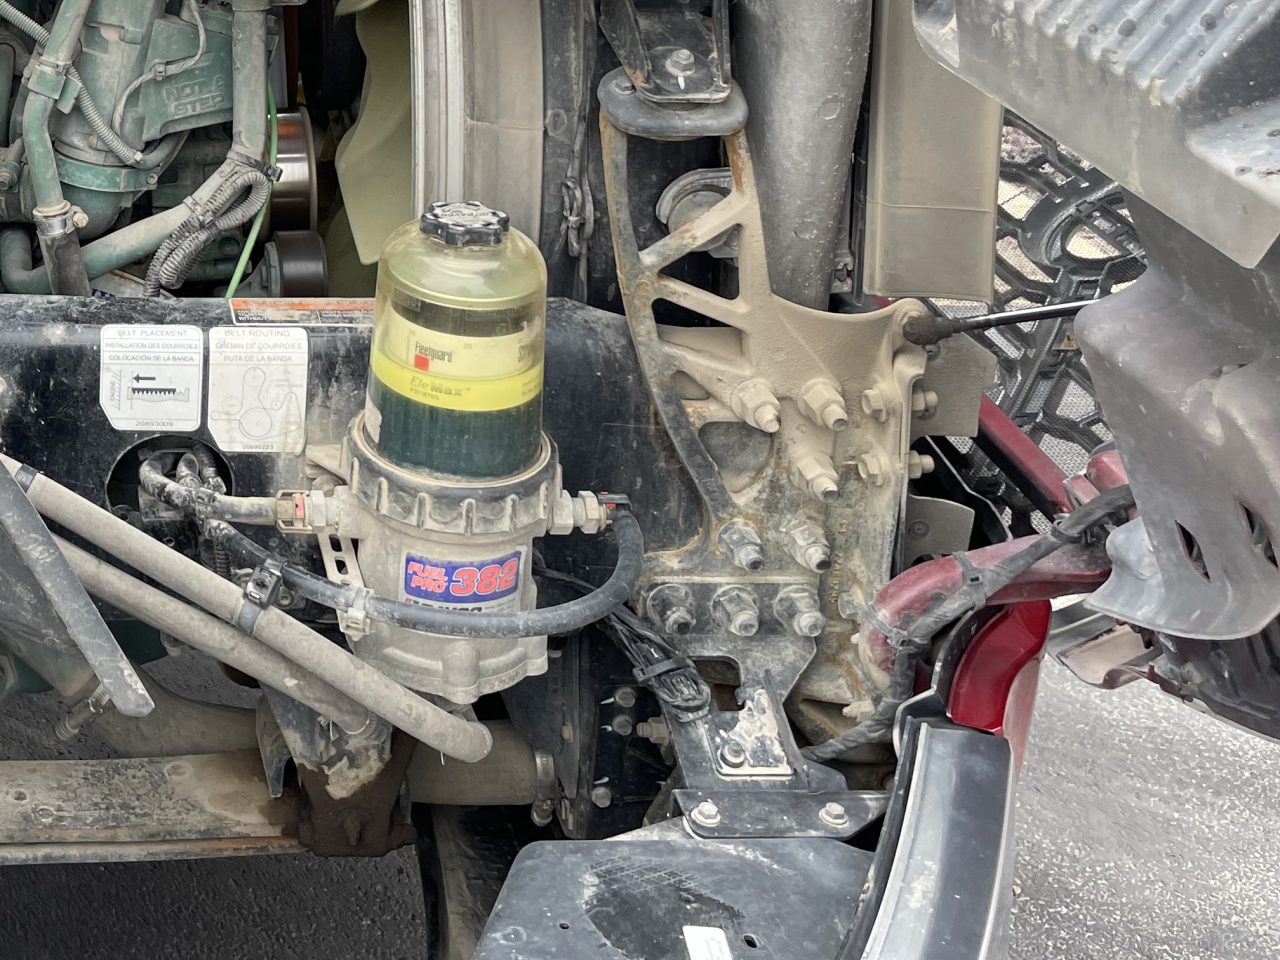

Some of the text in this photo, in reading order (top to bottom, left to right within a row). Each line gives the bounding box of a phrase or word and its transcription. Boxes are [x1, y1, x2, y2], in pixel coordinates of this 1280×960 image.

[117, 329, 188, 337] BELT PLACEMENT
[224, 329, 291, 337] BELT ROUTING
[215, 342, 244, 350] CHEMIN
[245, 342, 257, 350] DE
[415, 341, 453, 363] Fleetguard
[407, 561, 449, 582] FUEL
[449, 557, 519, 597] 382
[410, 574, 449, 594] PRO
